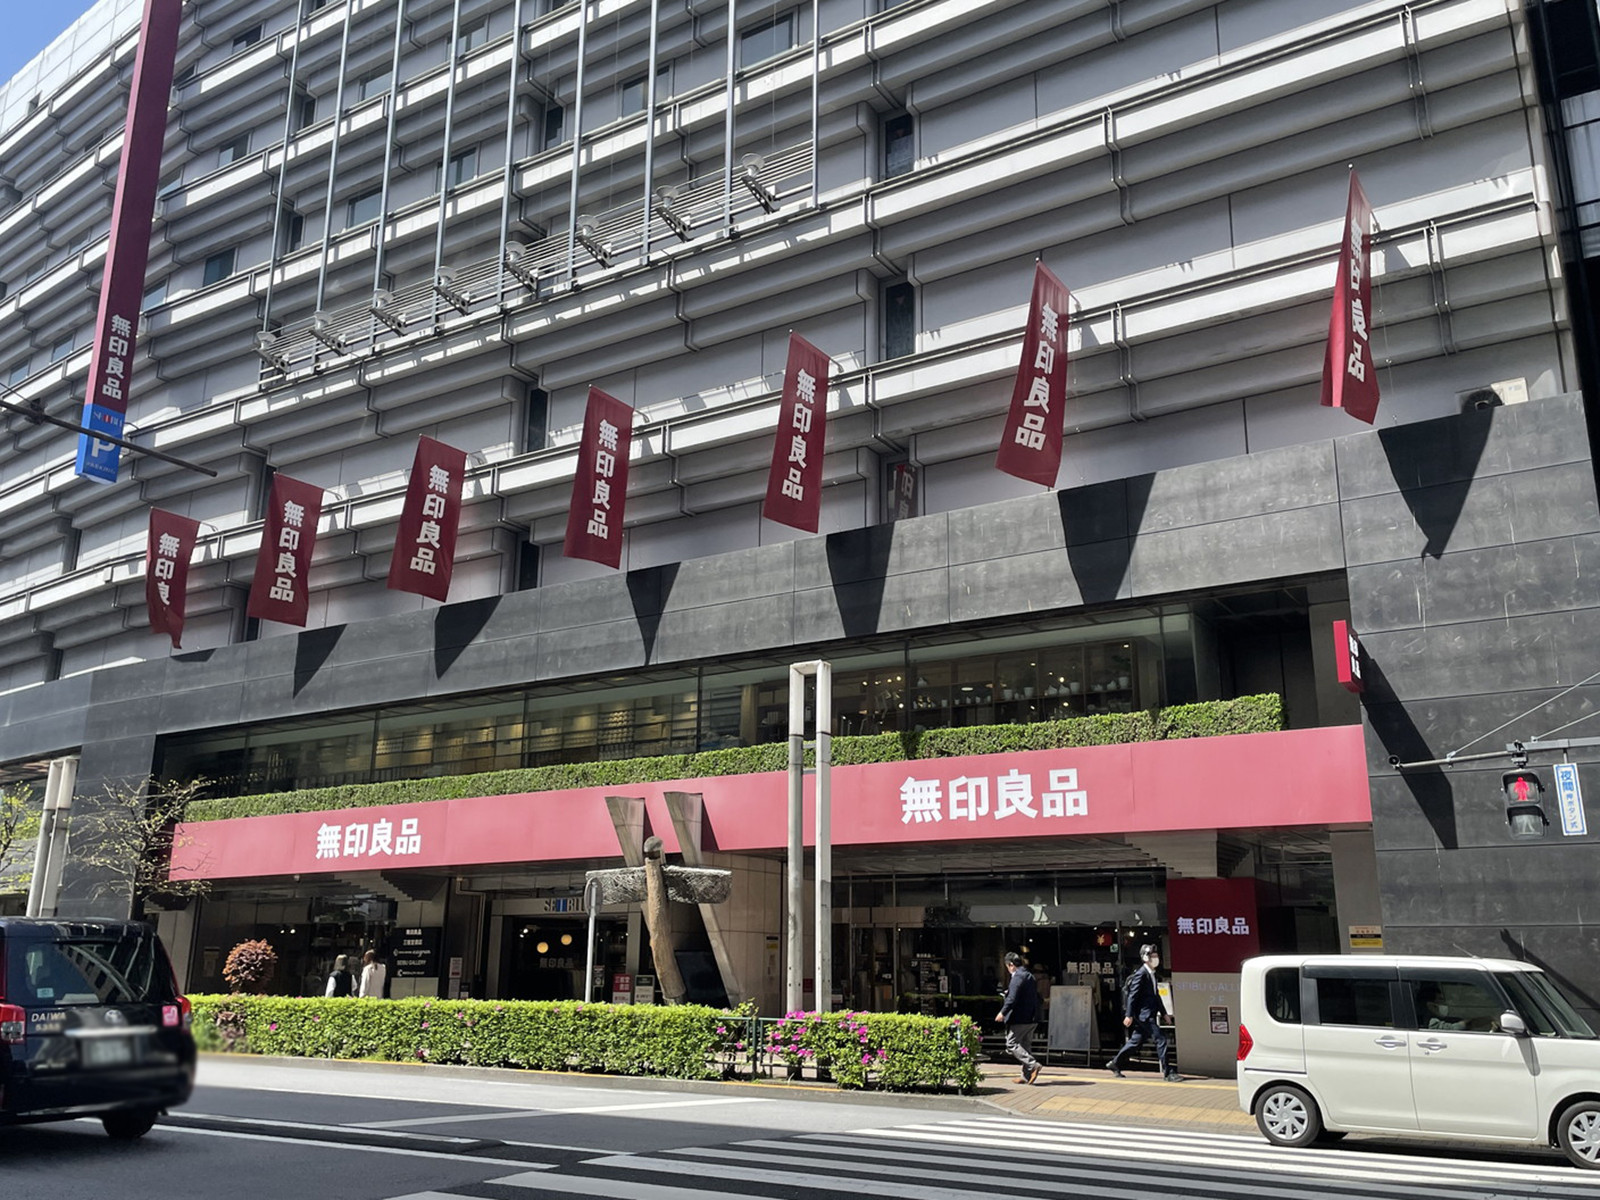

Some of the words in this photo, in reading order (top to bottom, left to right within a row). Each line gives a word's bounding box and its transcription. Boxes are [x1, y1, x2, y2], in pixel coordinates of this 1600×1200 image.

[101, 314, 132, 400] 無印良品
[1014, 303, 1059, 451] 無印良品
[91, 430, 116, 458] P
[780, 368, 816, 502] 無印良品
[586, 418, 619, 540] 無印良品
[269, 500, 305, 604] 無印良品
[409, 463, 450, 575] 無印良品
[154, 532, 181, 606] 無印良
[899, 768, 1088, 824] 無印良品
[315, 817, 422, 859] 無印良品
[1176, 915, 1250, 936] 無印良品
[1066, 961, 1114, 974] 無印良品
[31, 1012, 67, 1023] DAIWA
